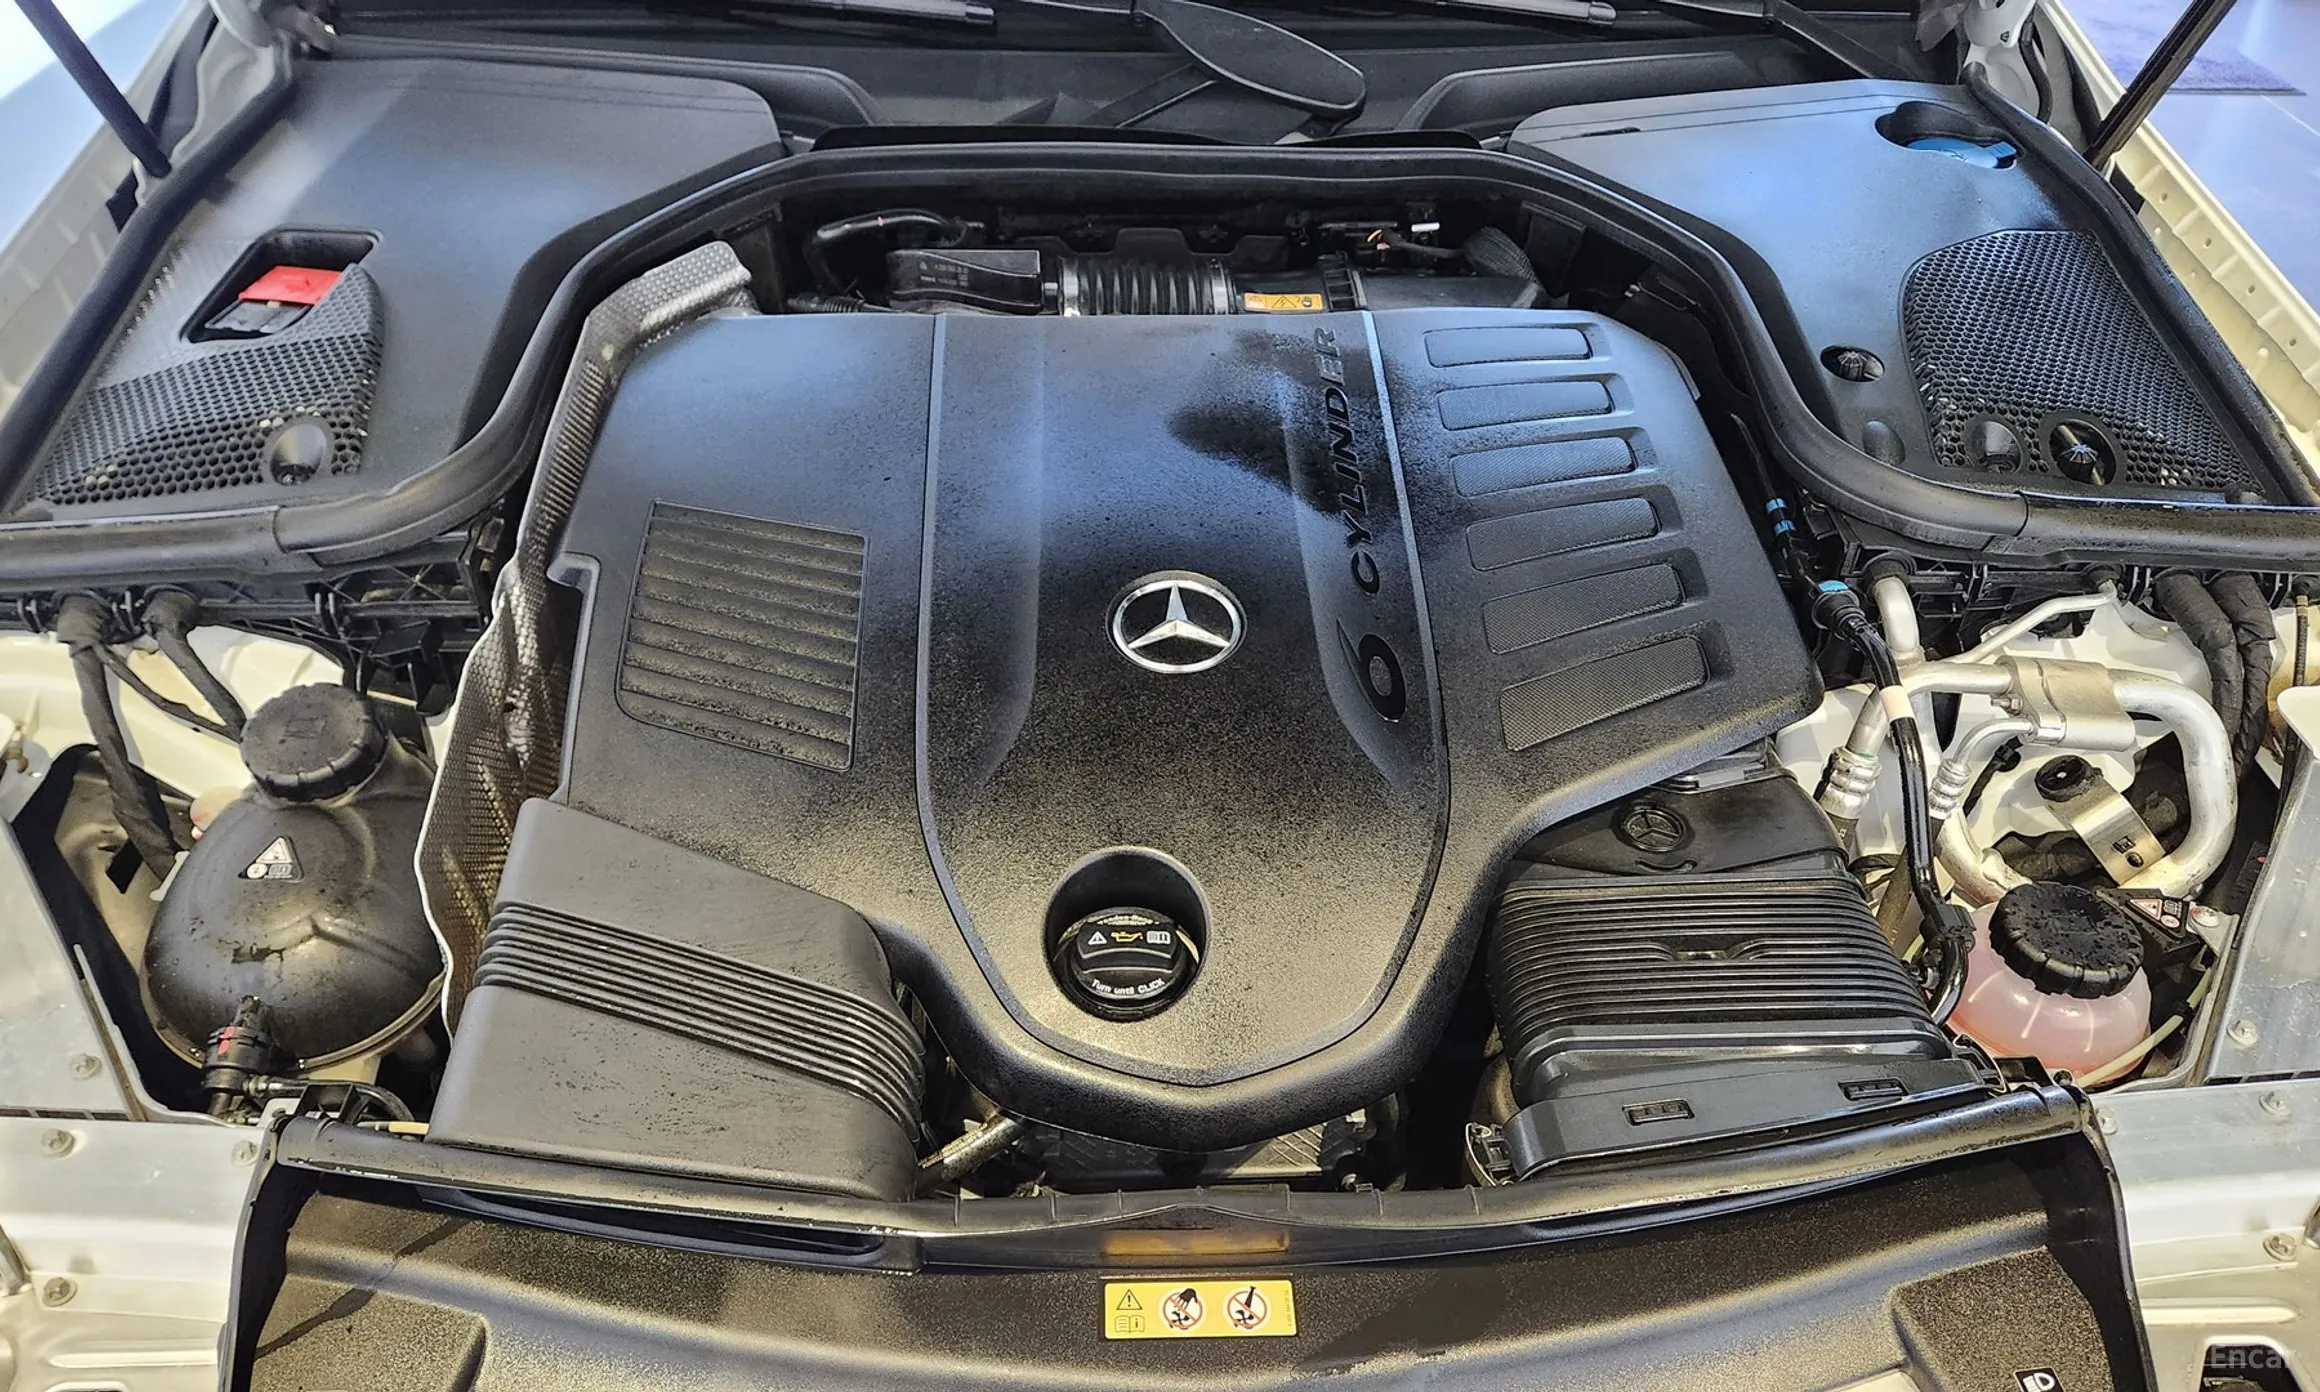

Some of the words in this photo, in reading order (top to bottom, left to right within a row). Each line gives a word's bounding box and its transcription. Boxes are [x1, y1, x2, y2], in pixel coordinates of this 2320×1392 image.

[1314, 326, 1380, 596] CYLINDER
[1336, 617, 1406, 722] 6
[1092, 979, 1111, 992] Turn
[1138, 978, 1165, 993] CLICK
